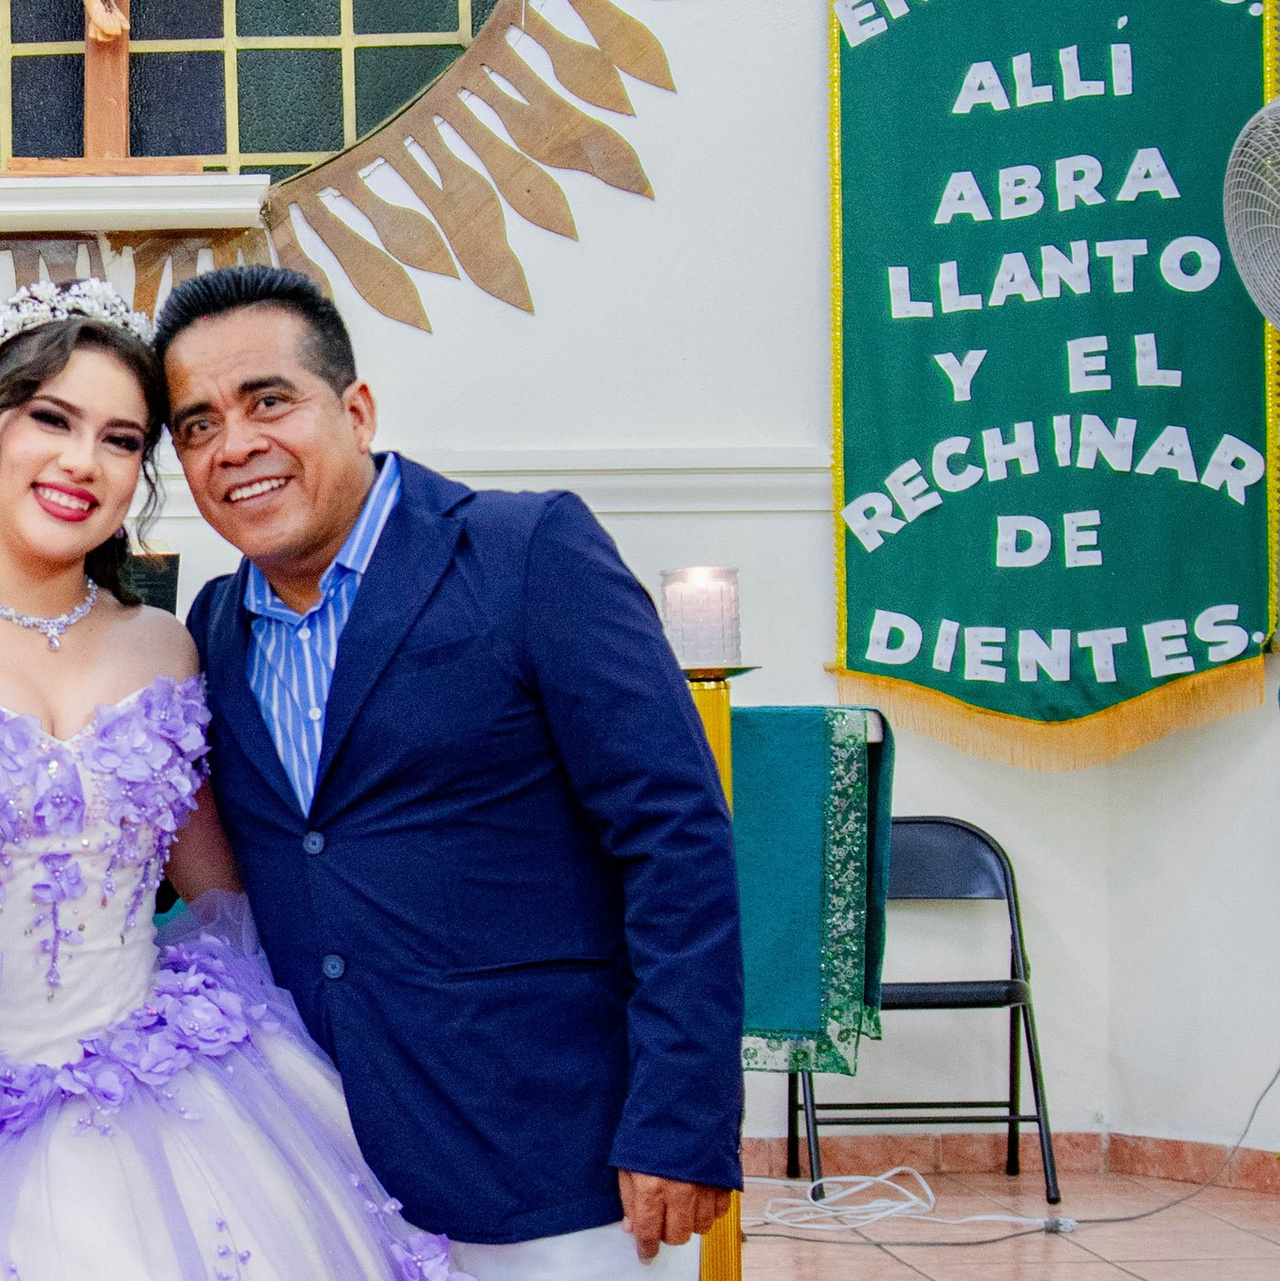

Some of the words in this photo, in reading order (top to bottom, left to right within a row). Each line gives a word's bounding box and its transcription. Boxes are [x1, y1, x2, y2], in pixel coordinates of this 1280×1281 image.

[952, 15, 1133, 114] ALLÍ
[934, 147, 1181, 225] ABRA
[888, 236, 1221, 319] LLANTO
[934, 349, 988, 402] Y
[1067, 333, 1182, 394] EL
[841, 414, 1265, 552] RECHINAR
[996, 510, 1103, 568] DE
[866, 605, 1265, 682] DIENTES.
